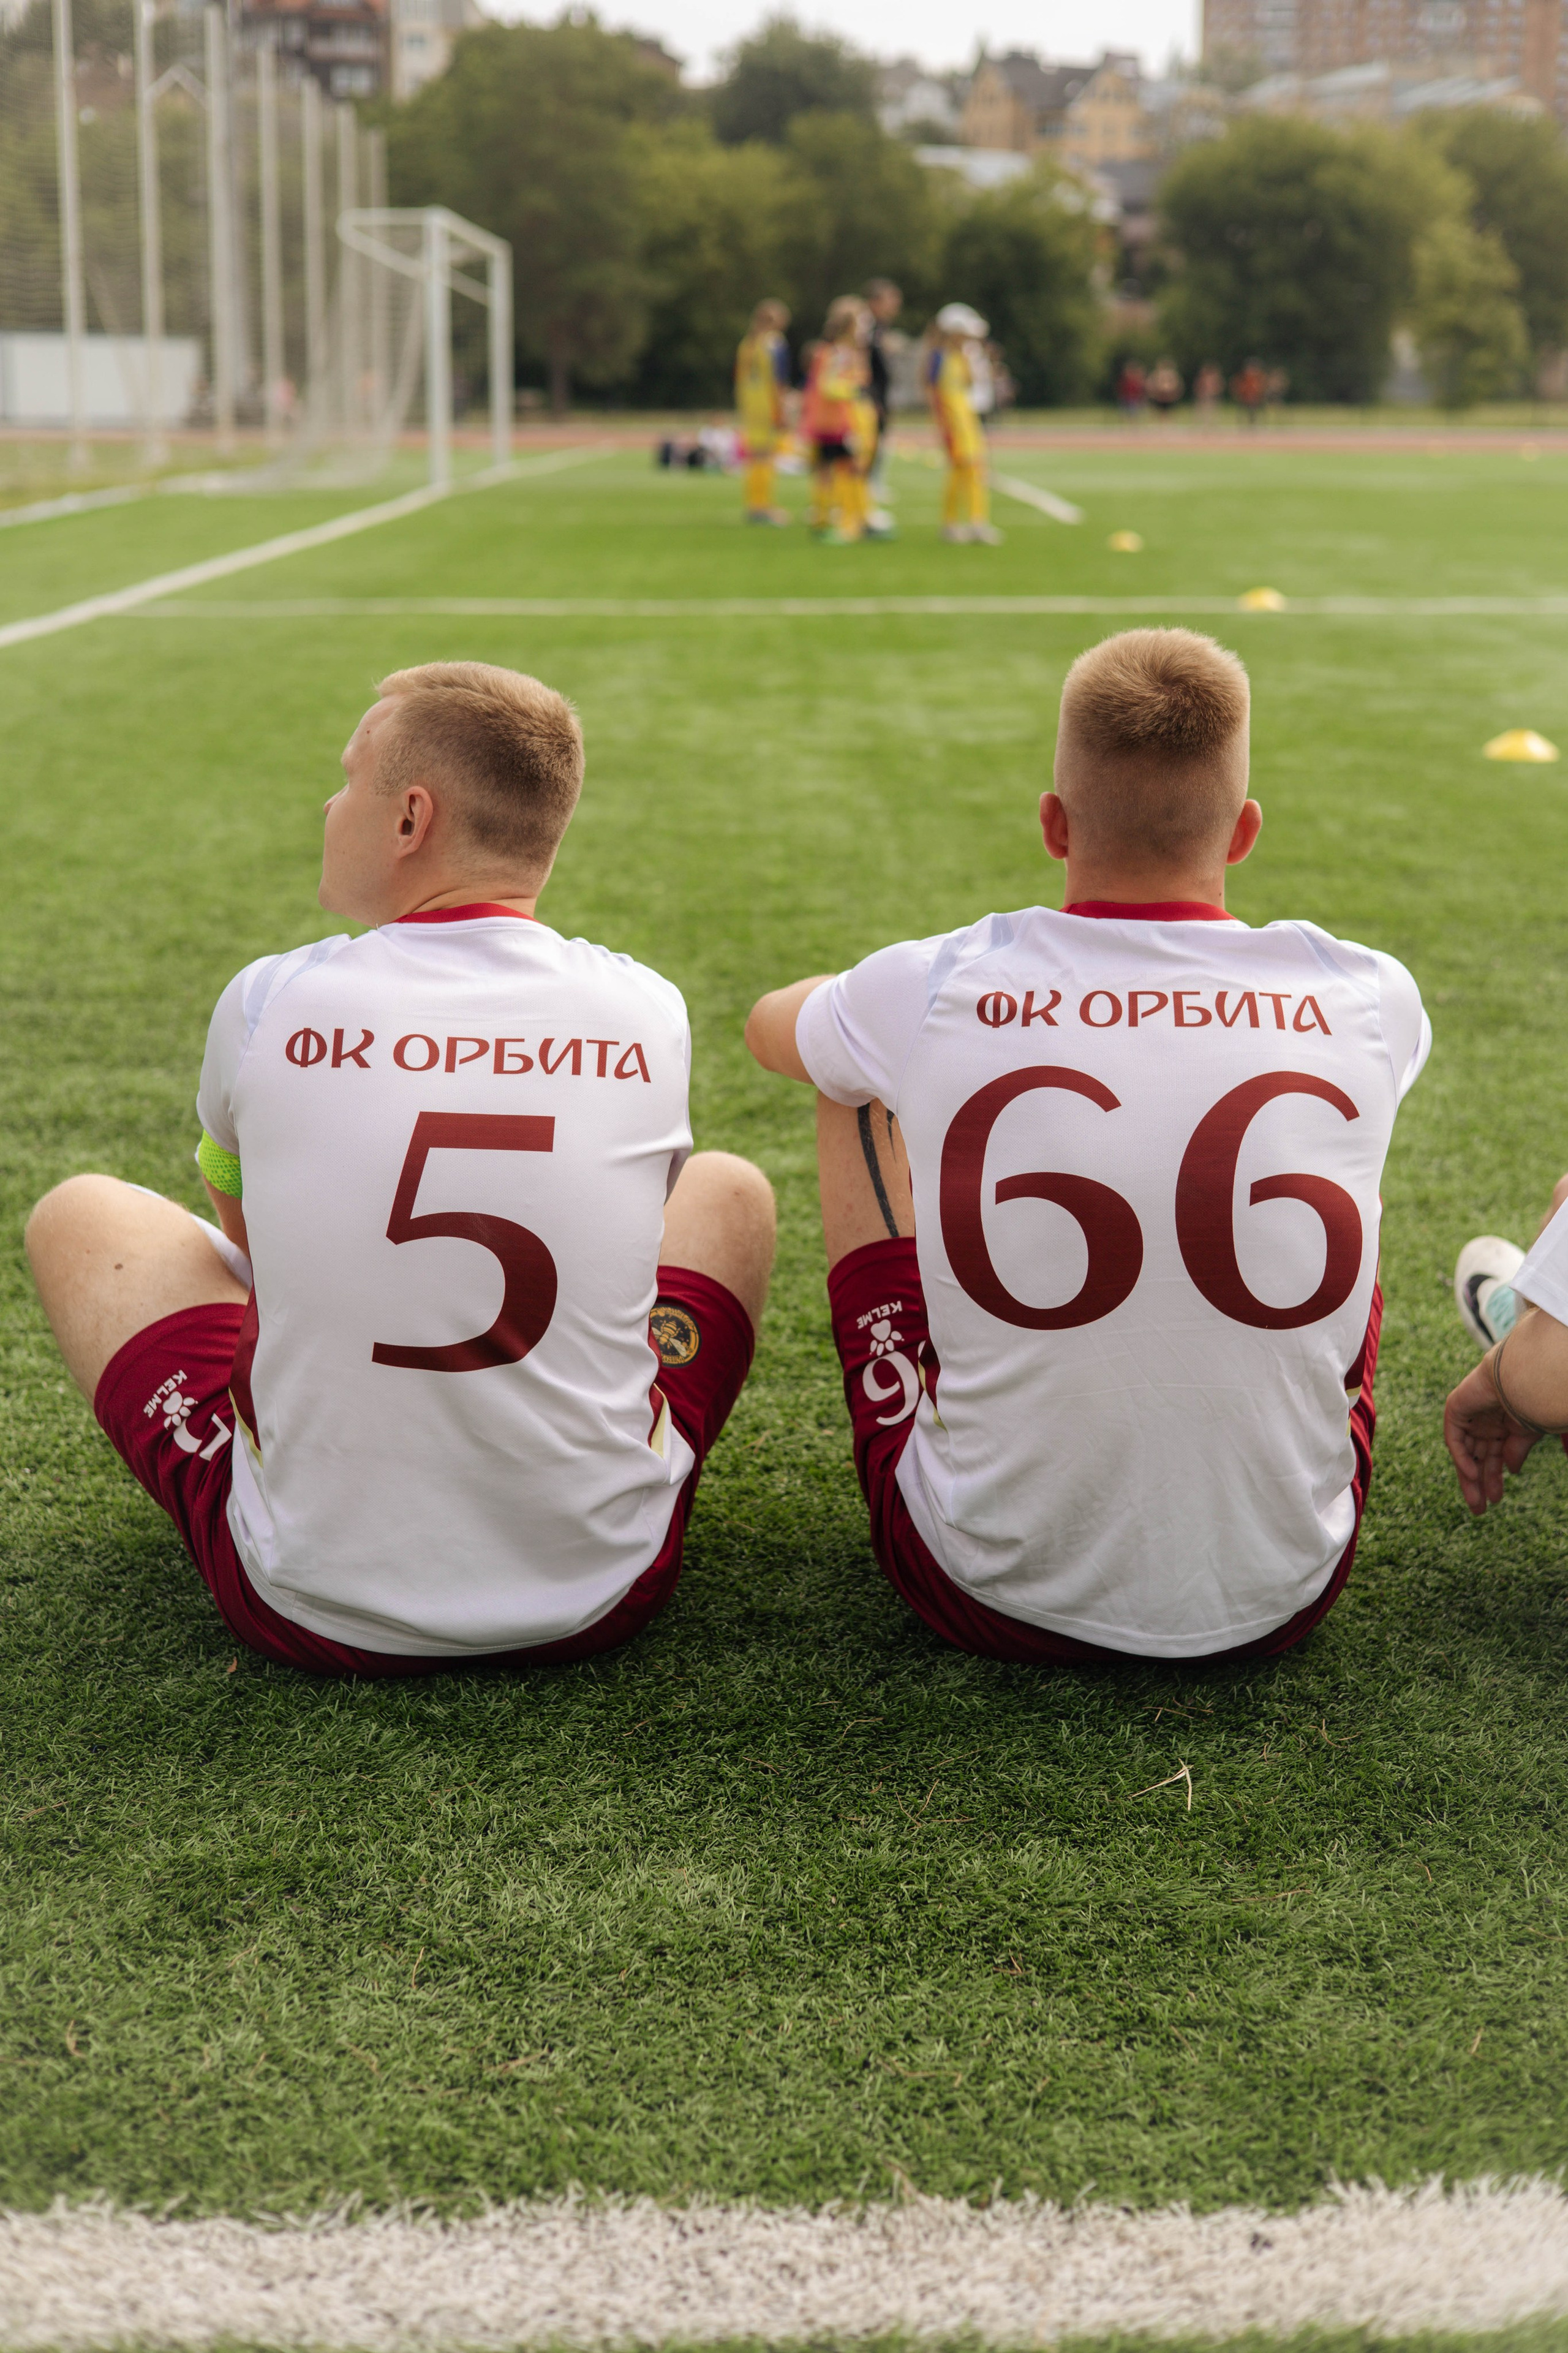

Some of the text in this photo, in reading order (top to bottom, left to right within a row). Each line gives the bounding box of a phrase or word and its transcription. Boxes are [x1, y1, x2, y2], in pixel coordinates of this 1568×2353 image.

[976, 990, 1332, 1035] ФК ОРБИТА
[284, 1027, 651, 1083] ФК ОРБИТА
[940, 1065, 1363, 1331] 66
[372, 1111, 557, 1372] 5
[857, 1301, 902, 1329] KELME
[143, 1369, 187, 1418] KELME
